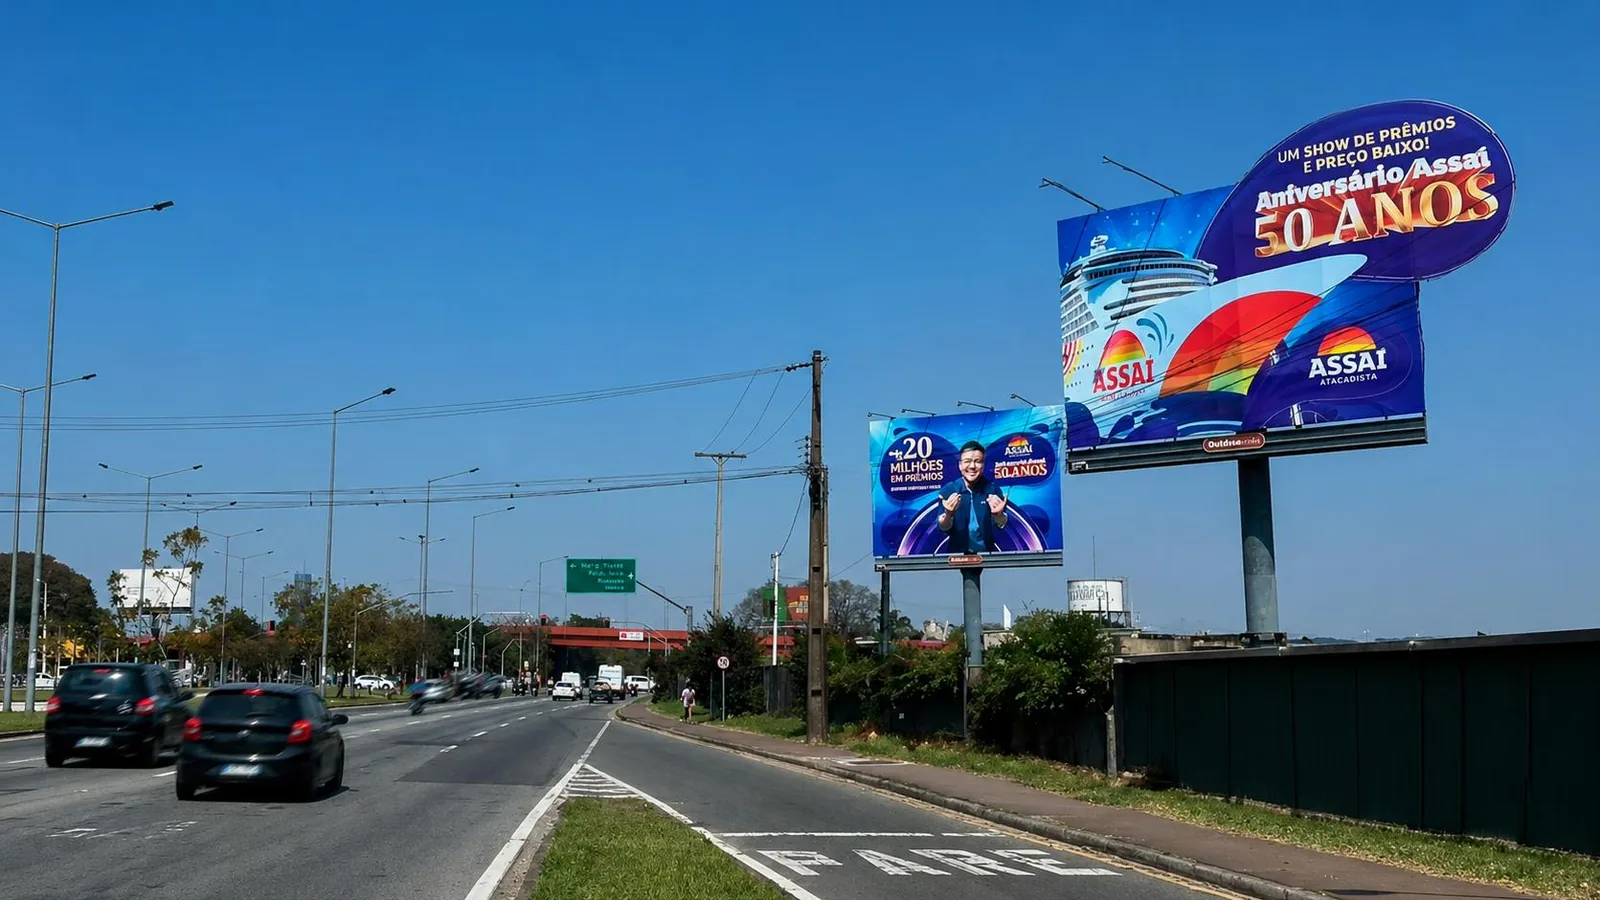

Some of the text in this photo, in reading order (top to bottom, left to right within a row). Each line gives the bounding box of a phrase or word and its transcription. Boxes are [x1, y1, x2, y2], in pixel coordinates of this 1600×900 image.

[1277, 116, 1456, 163] UM SHOW DE PRÊMIOS
[1303, 137, 1430, 173] E PREÇO BAIXO!
[1255, 146, 1491, 212] Aniversário Assaí
[1255, 173, 1499, 257] 50 ANOS
[1308, 347, 1387, 378] ASSAÍ
[1320, 373, 1377, 386] ATACADISTA
[890, 459, 943, 473] MILHÕES
